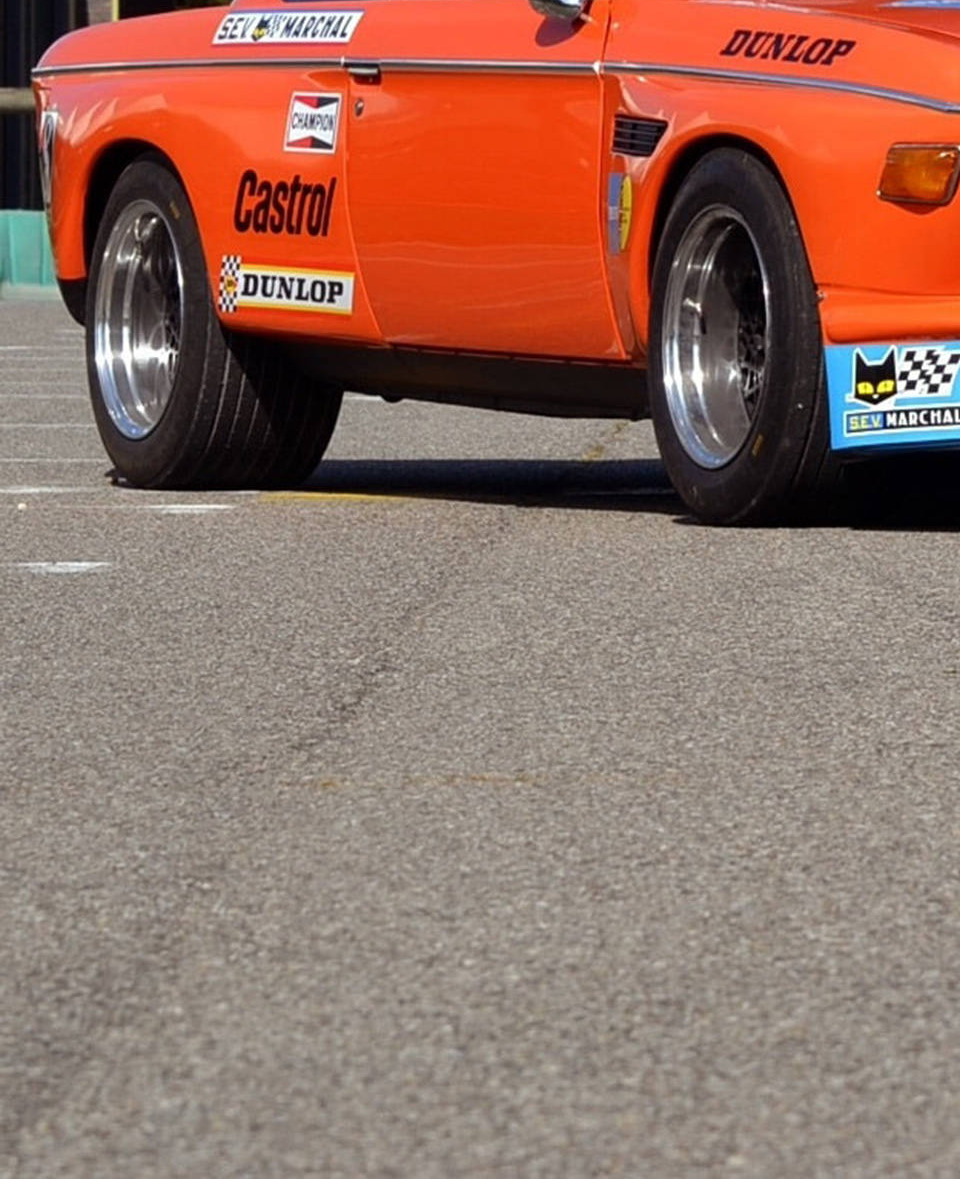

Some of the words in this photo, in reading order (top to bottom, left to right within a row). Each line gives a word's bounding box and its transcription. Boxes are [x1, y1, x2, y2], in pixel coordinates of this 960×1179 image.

[218, 17, 256, 40] SEV
[280, 15, 353, 38] MARCHAL
[719, 29, 856, 65] DUNLOP
[292, 112, 334, 131] CHAMPION
[233, 169, 337, 237] Castrol
[241, 274, 343, 303] DUNLOP
